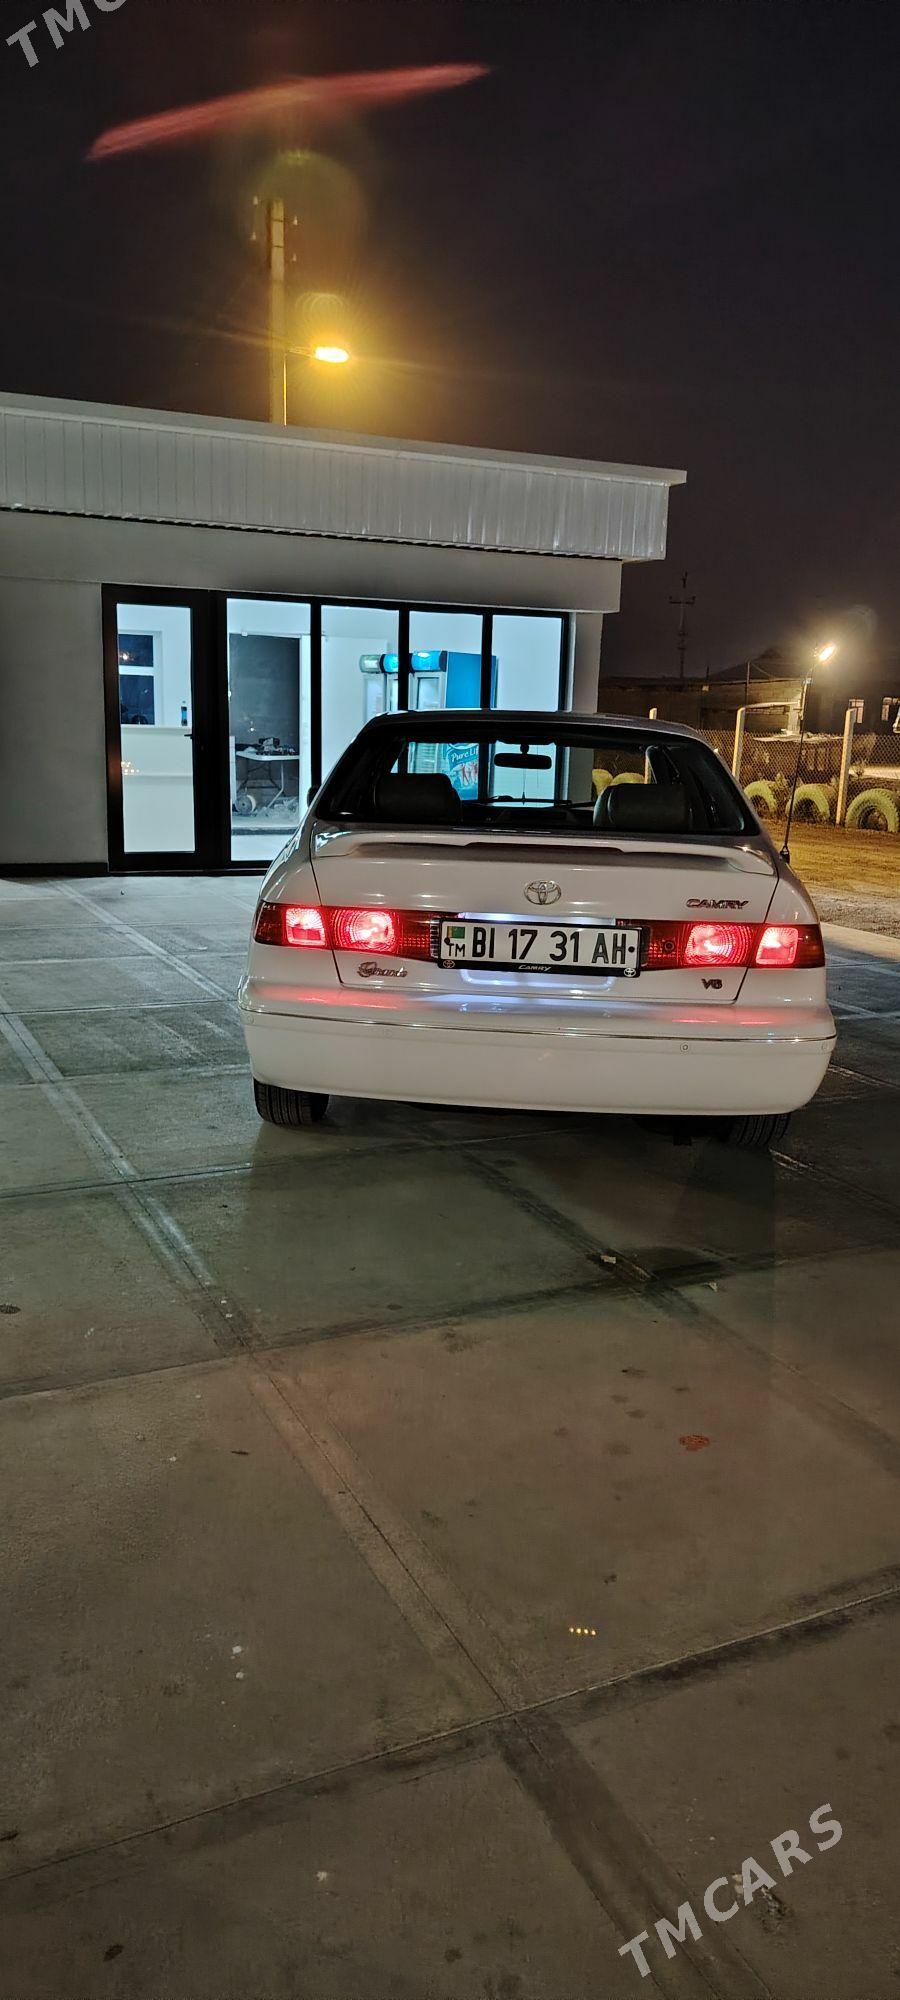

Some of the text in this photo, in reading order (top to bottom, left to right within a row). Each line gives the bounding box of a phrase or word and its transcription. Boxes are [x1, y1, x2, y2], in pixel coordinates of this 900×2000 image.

[686, 898, 749, 909] CAMRY
[447, 943, 466, 957] TM
[472, 926, 626, 964] BI 17 31 AH
[701, 978, 723, 990] V6
